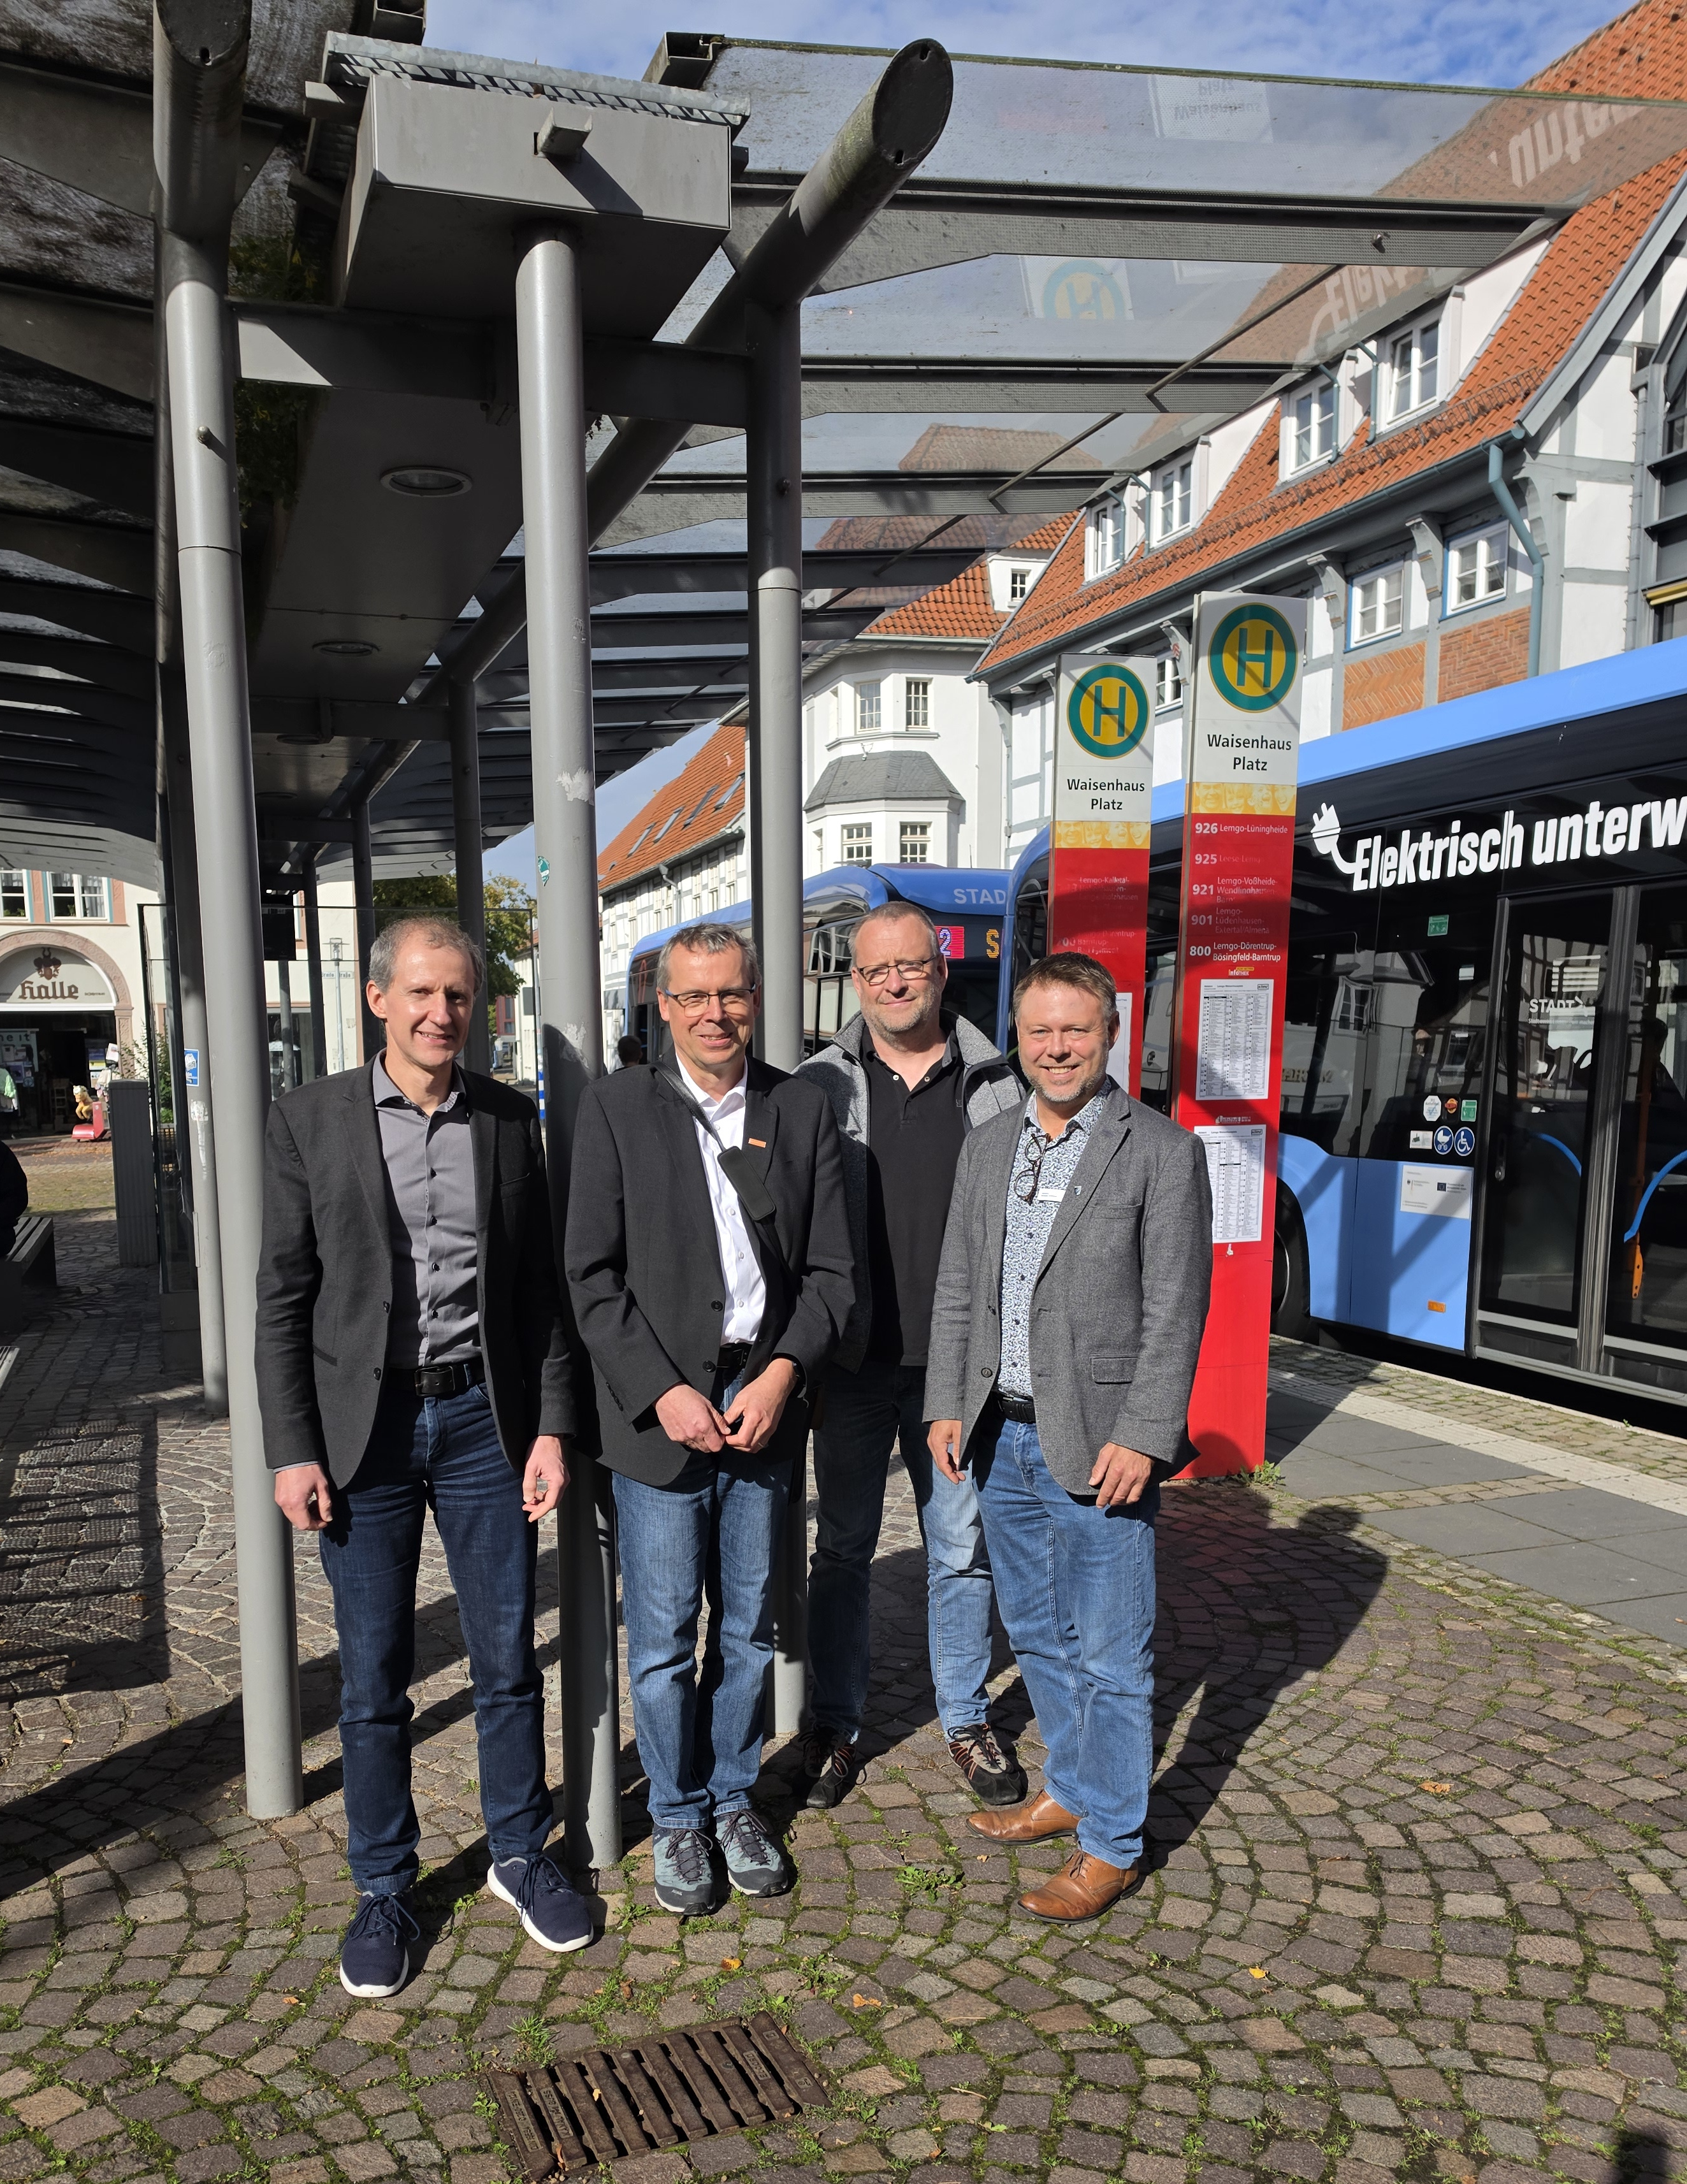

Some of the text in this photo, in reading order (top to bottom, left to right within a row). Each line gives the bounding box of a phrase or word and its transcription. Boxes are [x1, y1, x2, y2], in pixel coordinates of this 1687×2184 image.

[1236, 627, 1273, 688] H
[1093, 685, 1126, 737] H
[1206, 734, 1292, 751] Waisenhaus
[1233, 756, 1268, 771] Platz
[1067, 777, 1145, 792] Waisenhaus
[1090, 798, 1123, 810] Platz
[1195, 823, 1288, 834] 926 Lemgo-Lüningheide
[1352, 795, 1687, 892] Elektrisch unterw
[1195, 853, 1217, 864] 925
[1192, 884, 1214, 895] 921
[953, 888, 1006, 904] STAD
[1216, 908, 1243, 916] Lemgo-
[1191, 915, 1212, 925] 901
[1189, 946, 1211, 956] 800
[1213, 941, 1277, 951] Lemgo-Dörentrup-
[1213, 953, 1281, 962] Bösingfeld-Barntrup
